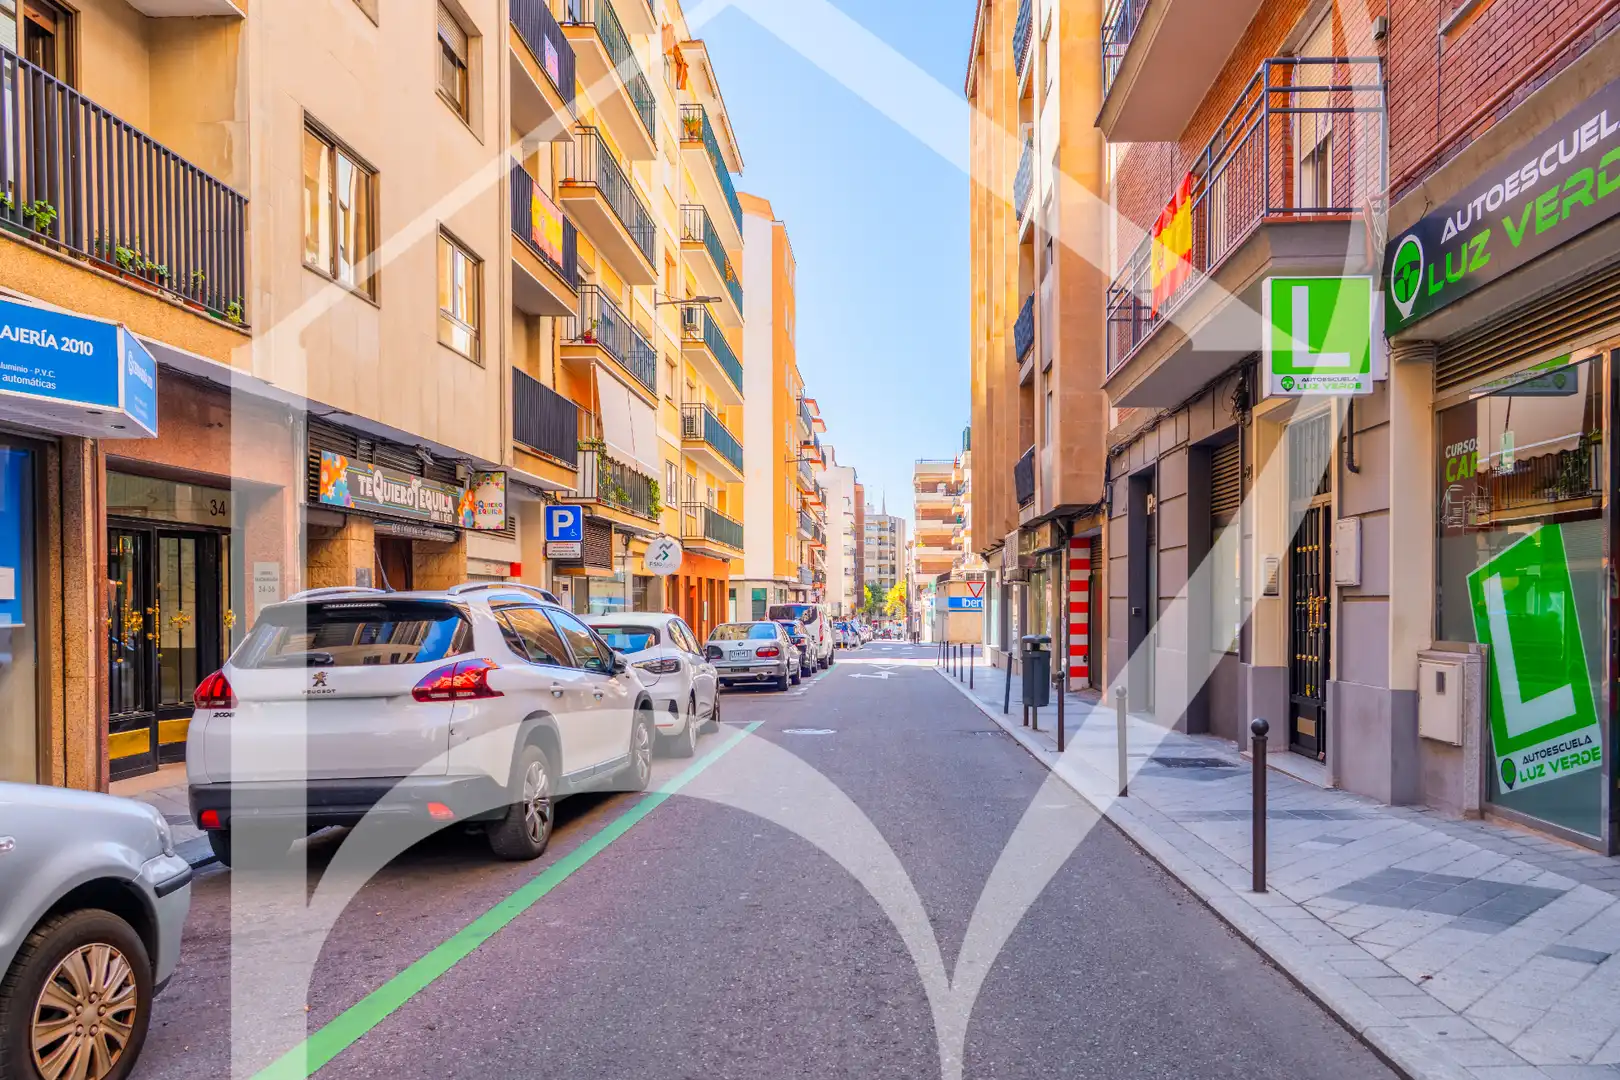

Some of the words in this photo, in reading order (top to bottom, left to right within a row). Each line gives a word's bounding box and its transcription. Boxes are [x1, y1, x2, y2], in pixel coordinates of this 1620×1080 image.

[1440, 109, 1620, 245] AUTOESCUEL
[1428, 228, 1492, 296] LUZ
[0, 324, 58, 350] AJERÍA
[61, 336, 94, 356] 2010
[1292, 286, 1350, 367] L
[2, 374, 56, 389] automáticas
[34, 367, 56, 378] P.V.C.
[1297, 382, 1319, 390] LUZ
[210, 499, 226, 516] 34
[552, 510, 575, 537] P
[1483, 571, 1577, 739] L
[1519, 764, 1546, 782] LUZ
[1548, 746, 1602, 774] VERDE
[1522, 735, 1592, 764] AUTOESCUELA
